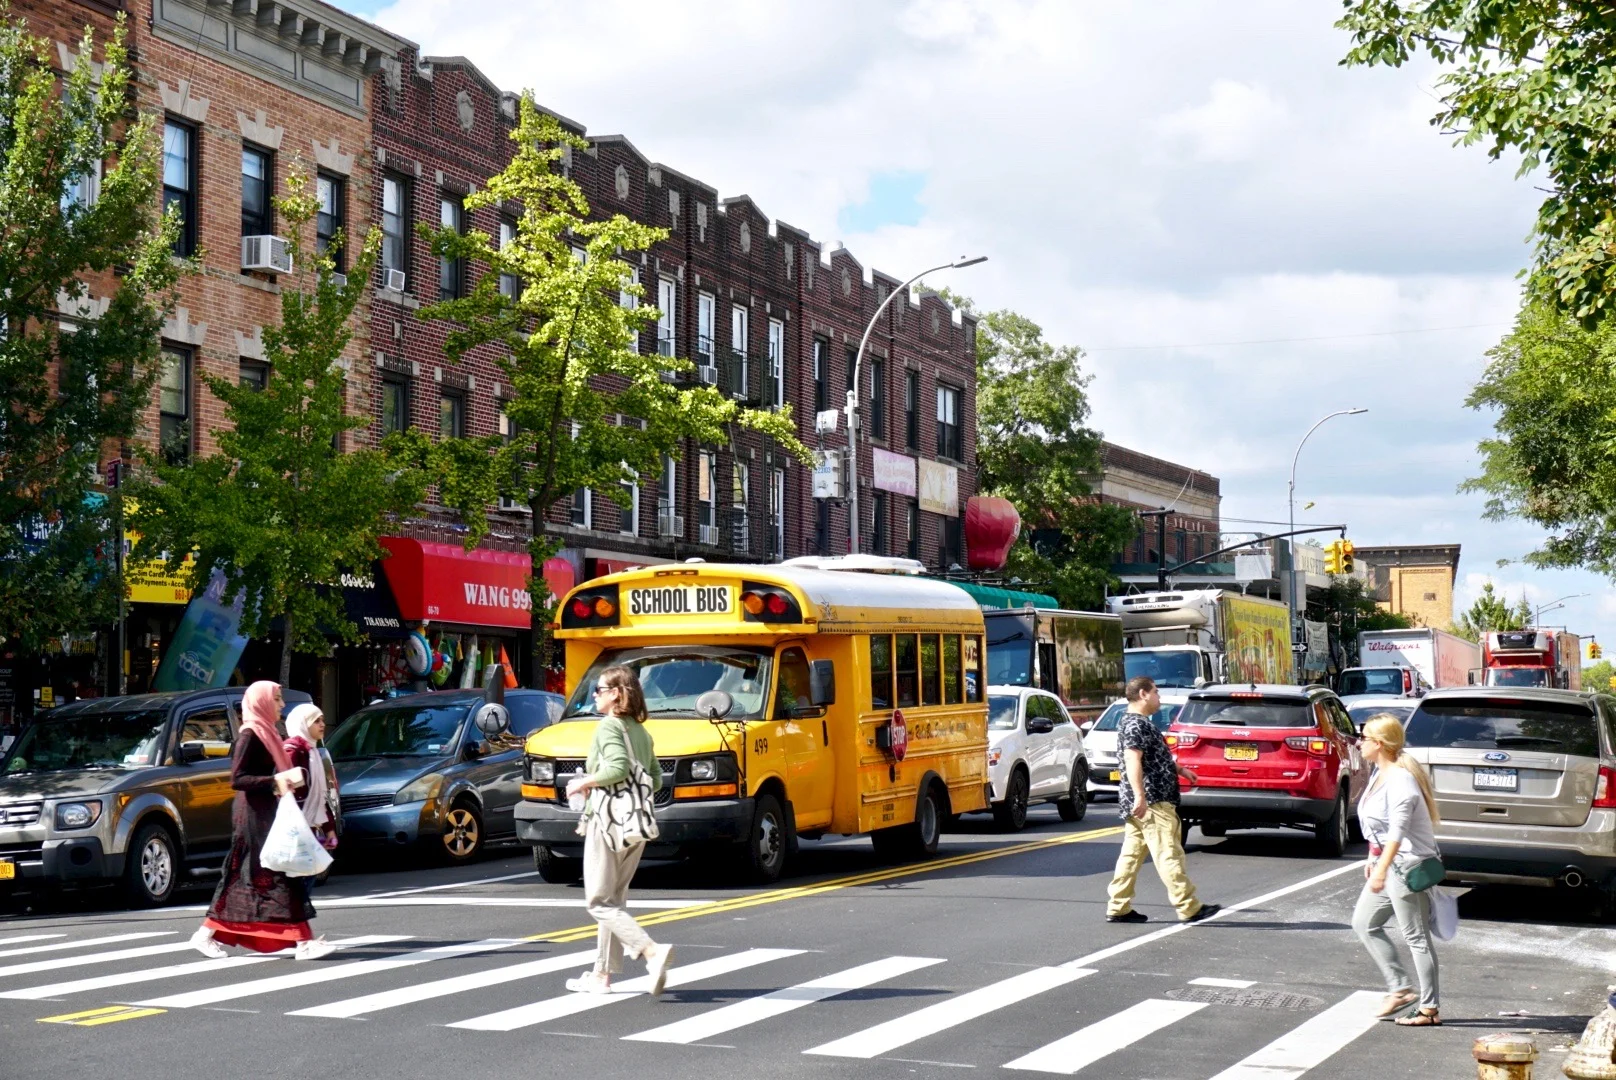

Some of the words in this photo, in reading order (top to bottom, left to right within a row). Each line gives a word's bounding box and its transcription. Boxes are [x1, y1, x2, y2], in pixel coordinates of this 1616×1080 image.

[464, 582, 509, 608] WANG
[631, 588, 691, 615] SCHOOL
[696, 586, 728, 612] BUS
[1367, 641, 1421, 654] Walgreens
[178, 651, 216, 685] total
[754, 737, 768, 756] 499
[893, 725, 906, 746] STOP
